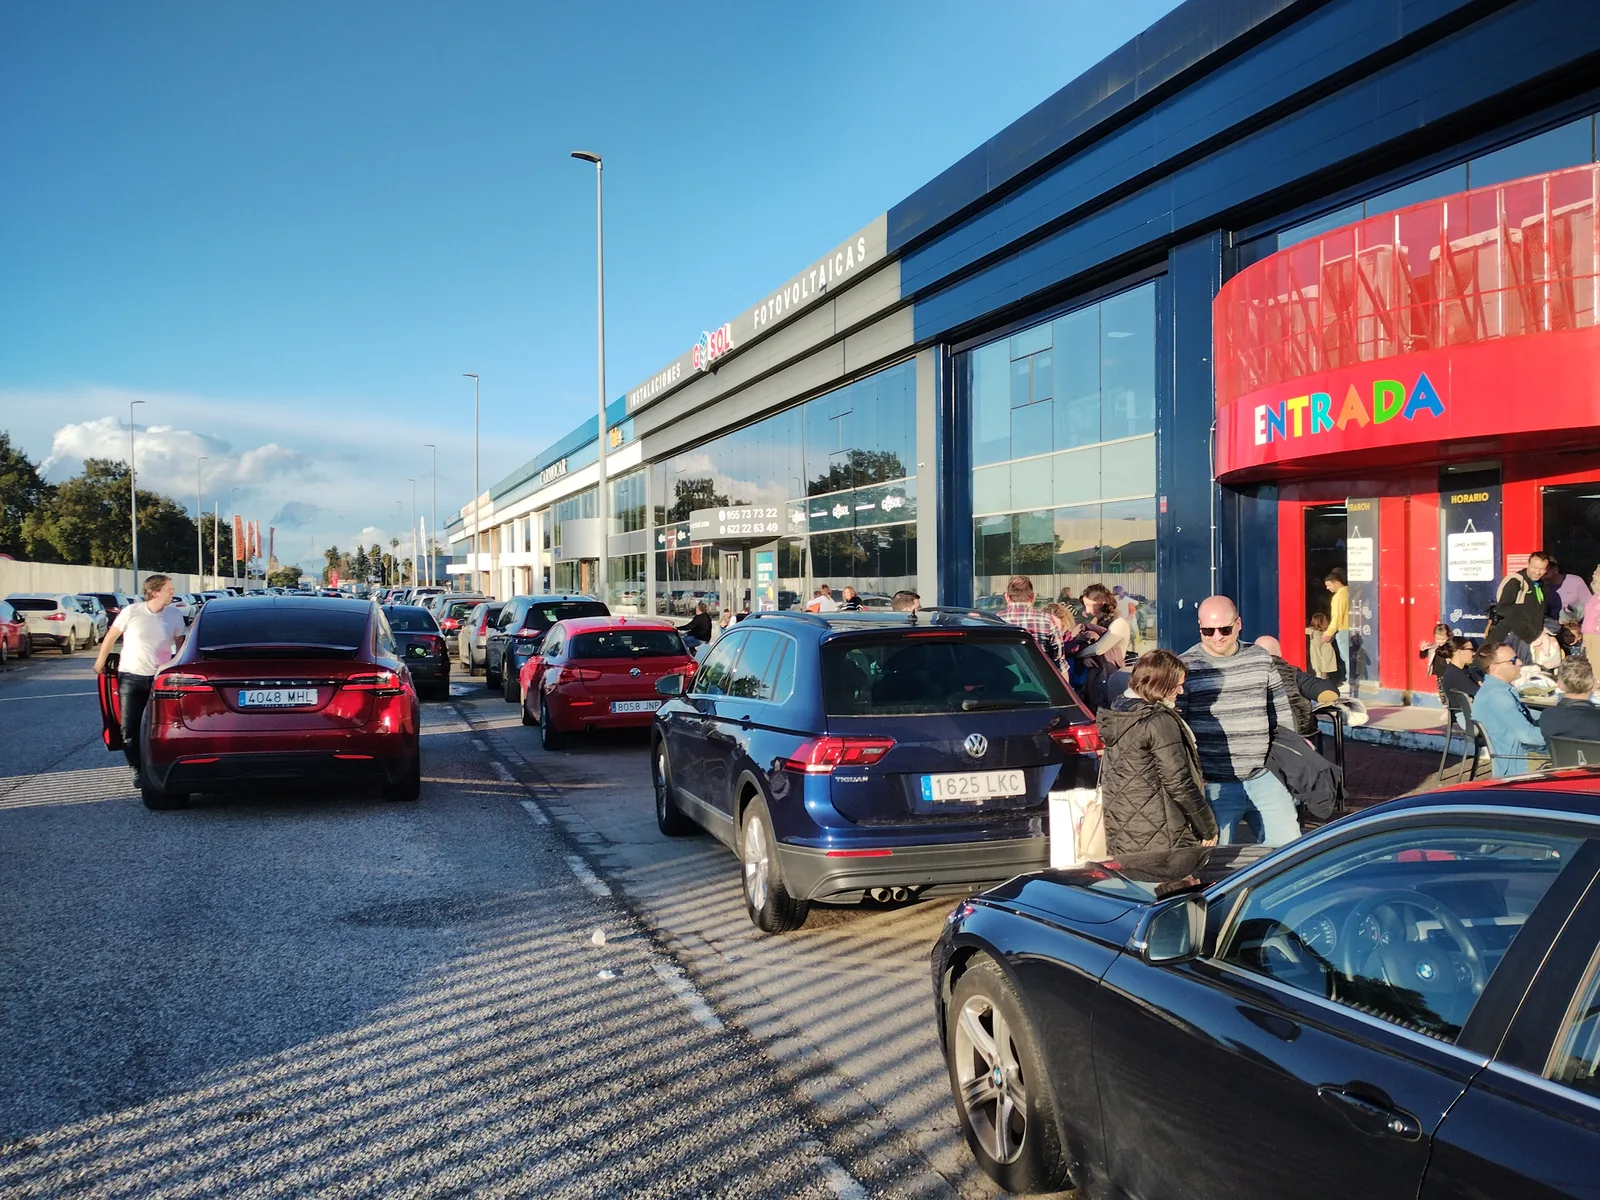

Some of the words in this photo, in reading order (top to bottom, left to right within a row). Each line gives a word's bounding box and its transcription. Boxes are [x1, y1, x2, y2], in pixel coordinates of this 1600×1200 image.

[630, 362, 681, 409] INSTALACIONES
[754, 237, 866, 330] FOTOVOLTAICAS
[1254, 371, 1446, 446] ENTRADA
[1451, 492, 1490, 504] HORARIO
[726, 510, 740, 520] 955
[741, 509, 751, 519] 73
[753, 509, 764, 518] 73
[766, 508, 778, 518] 22
[727, 524, 740, 534] 622
[742, 523, 752, 533] 22
[753, 523, 765, 533] 63
[766, 522, 779, 533] 49
[248, 692, 282, 703] 4048
[287, 691, 314, 702] MHL
[618, 702, 640, 711] 8058
[644, 701, 660, 710] JNP
[936, 776, 980, 796] 1625
[986, 774, 1020, 793] LKC
